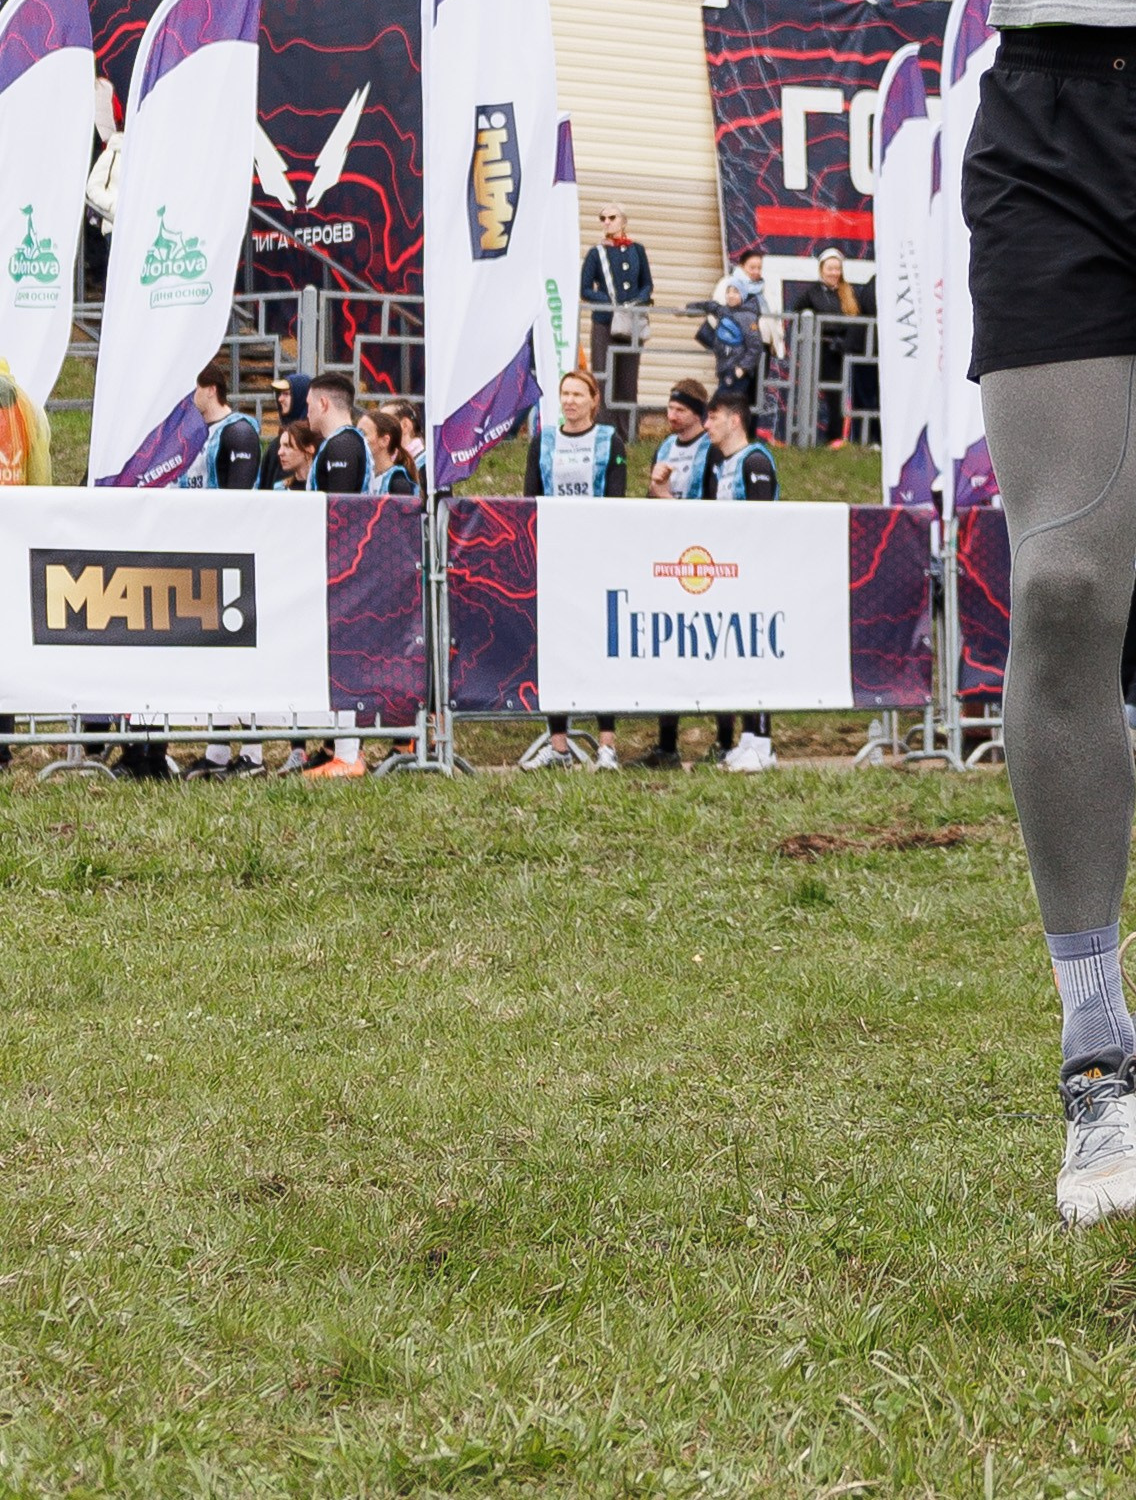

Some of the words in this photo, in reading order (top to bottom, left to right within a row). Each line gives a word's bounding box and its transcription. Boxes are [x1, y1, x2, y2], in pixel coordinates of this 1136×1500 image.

[557, 481, 589, 497] 5592
[655, 562, 694, 577] РУССКИЙ
[698, 564, 737, 577] ПРОДУКТ
[46, 564, 244, 632] МАТЧ!
